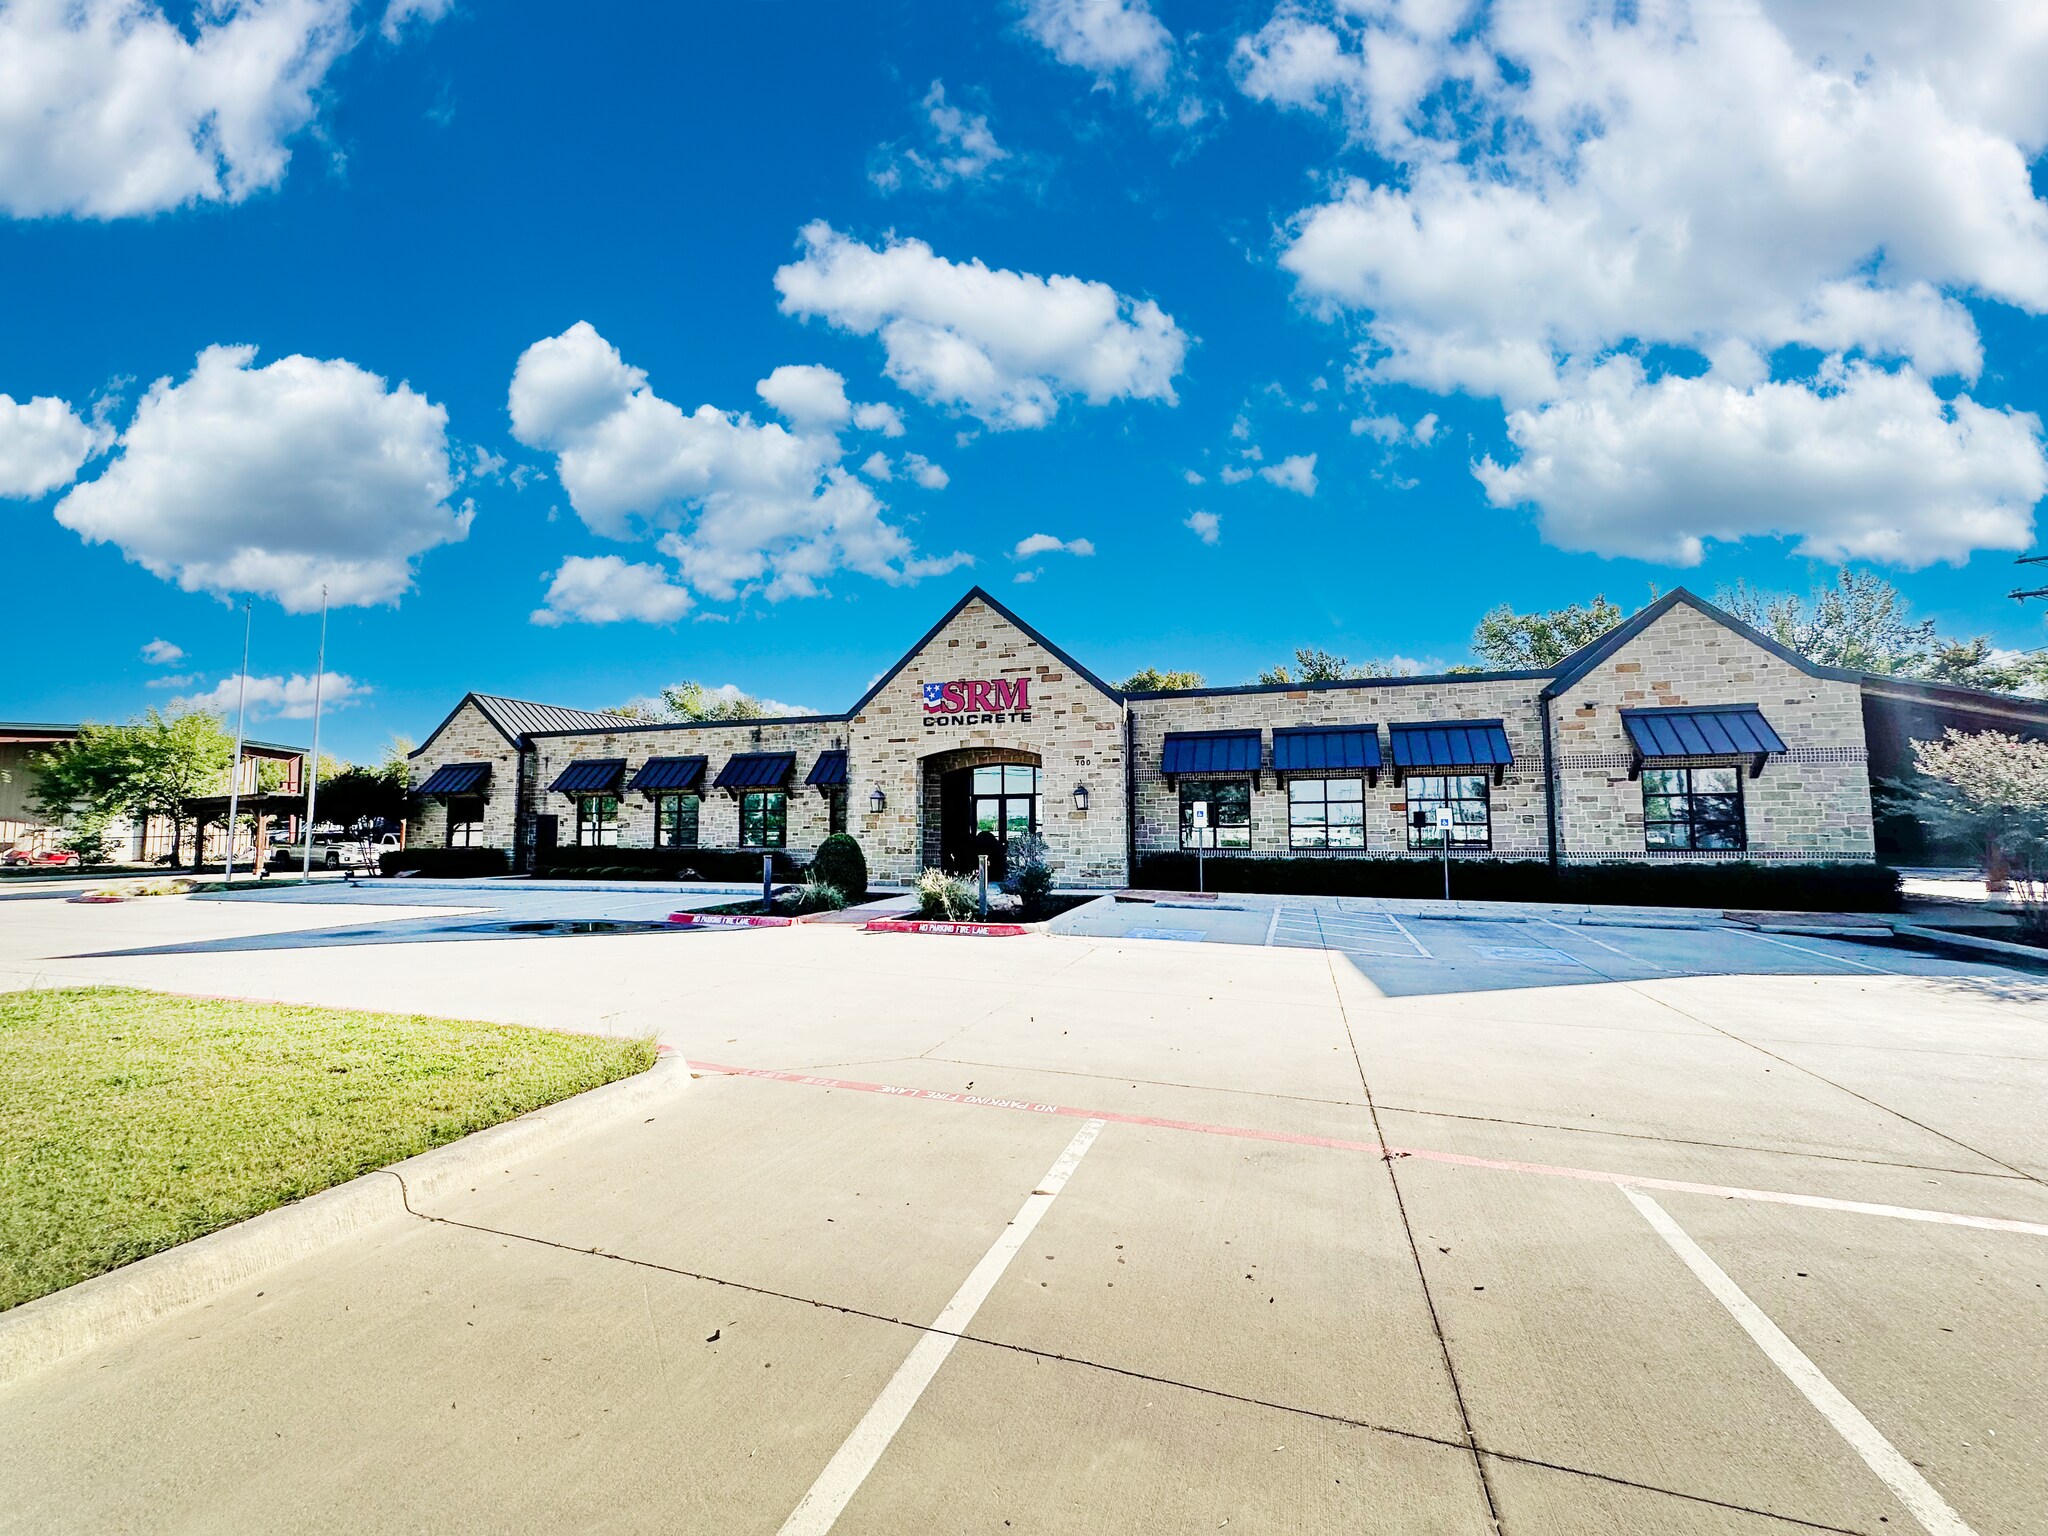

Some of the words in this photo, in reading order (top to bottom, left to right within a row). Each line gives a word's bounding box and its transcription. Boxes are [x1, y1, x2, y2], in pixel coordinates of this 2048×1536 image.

[940, 677, 1032, 714] SRM
[922, 713, 1032, 727] CONCRETE
[702, 915, 721, 924] PARKING
[722, 917, 735, 925] FIRE
[736, 917, 750, 925] LANE
[929, 924, 954, 932] PARKING
[956, 925, 971, 934] FIRE
[972, 927, 989, 935] LANE
[876, 1085, 919, 1096] LANE
[922, 1091, 960, 1101] FIRE
[963, 1095, 1029, 1110] PARKING
[1033, 1104, 1057, 1113] NO
